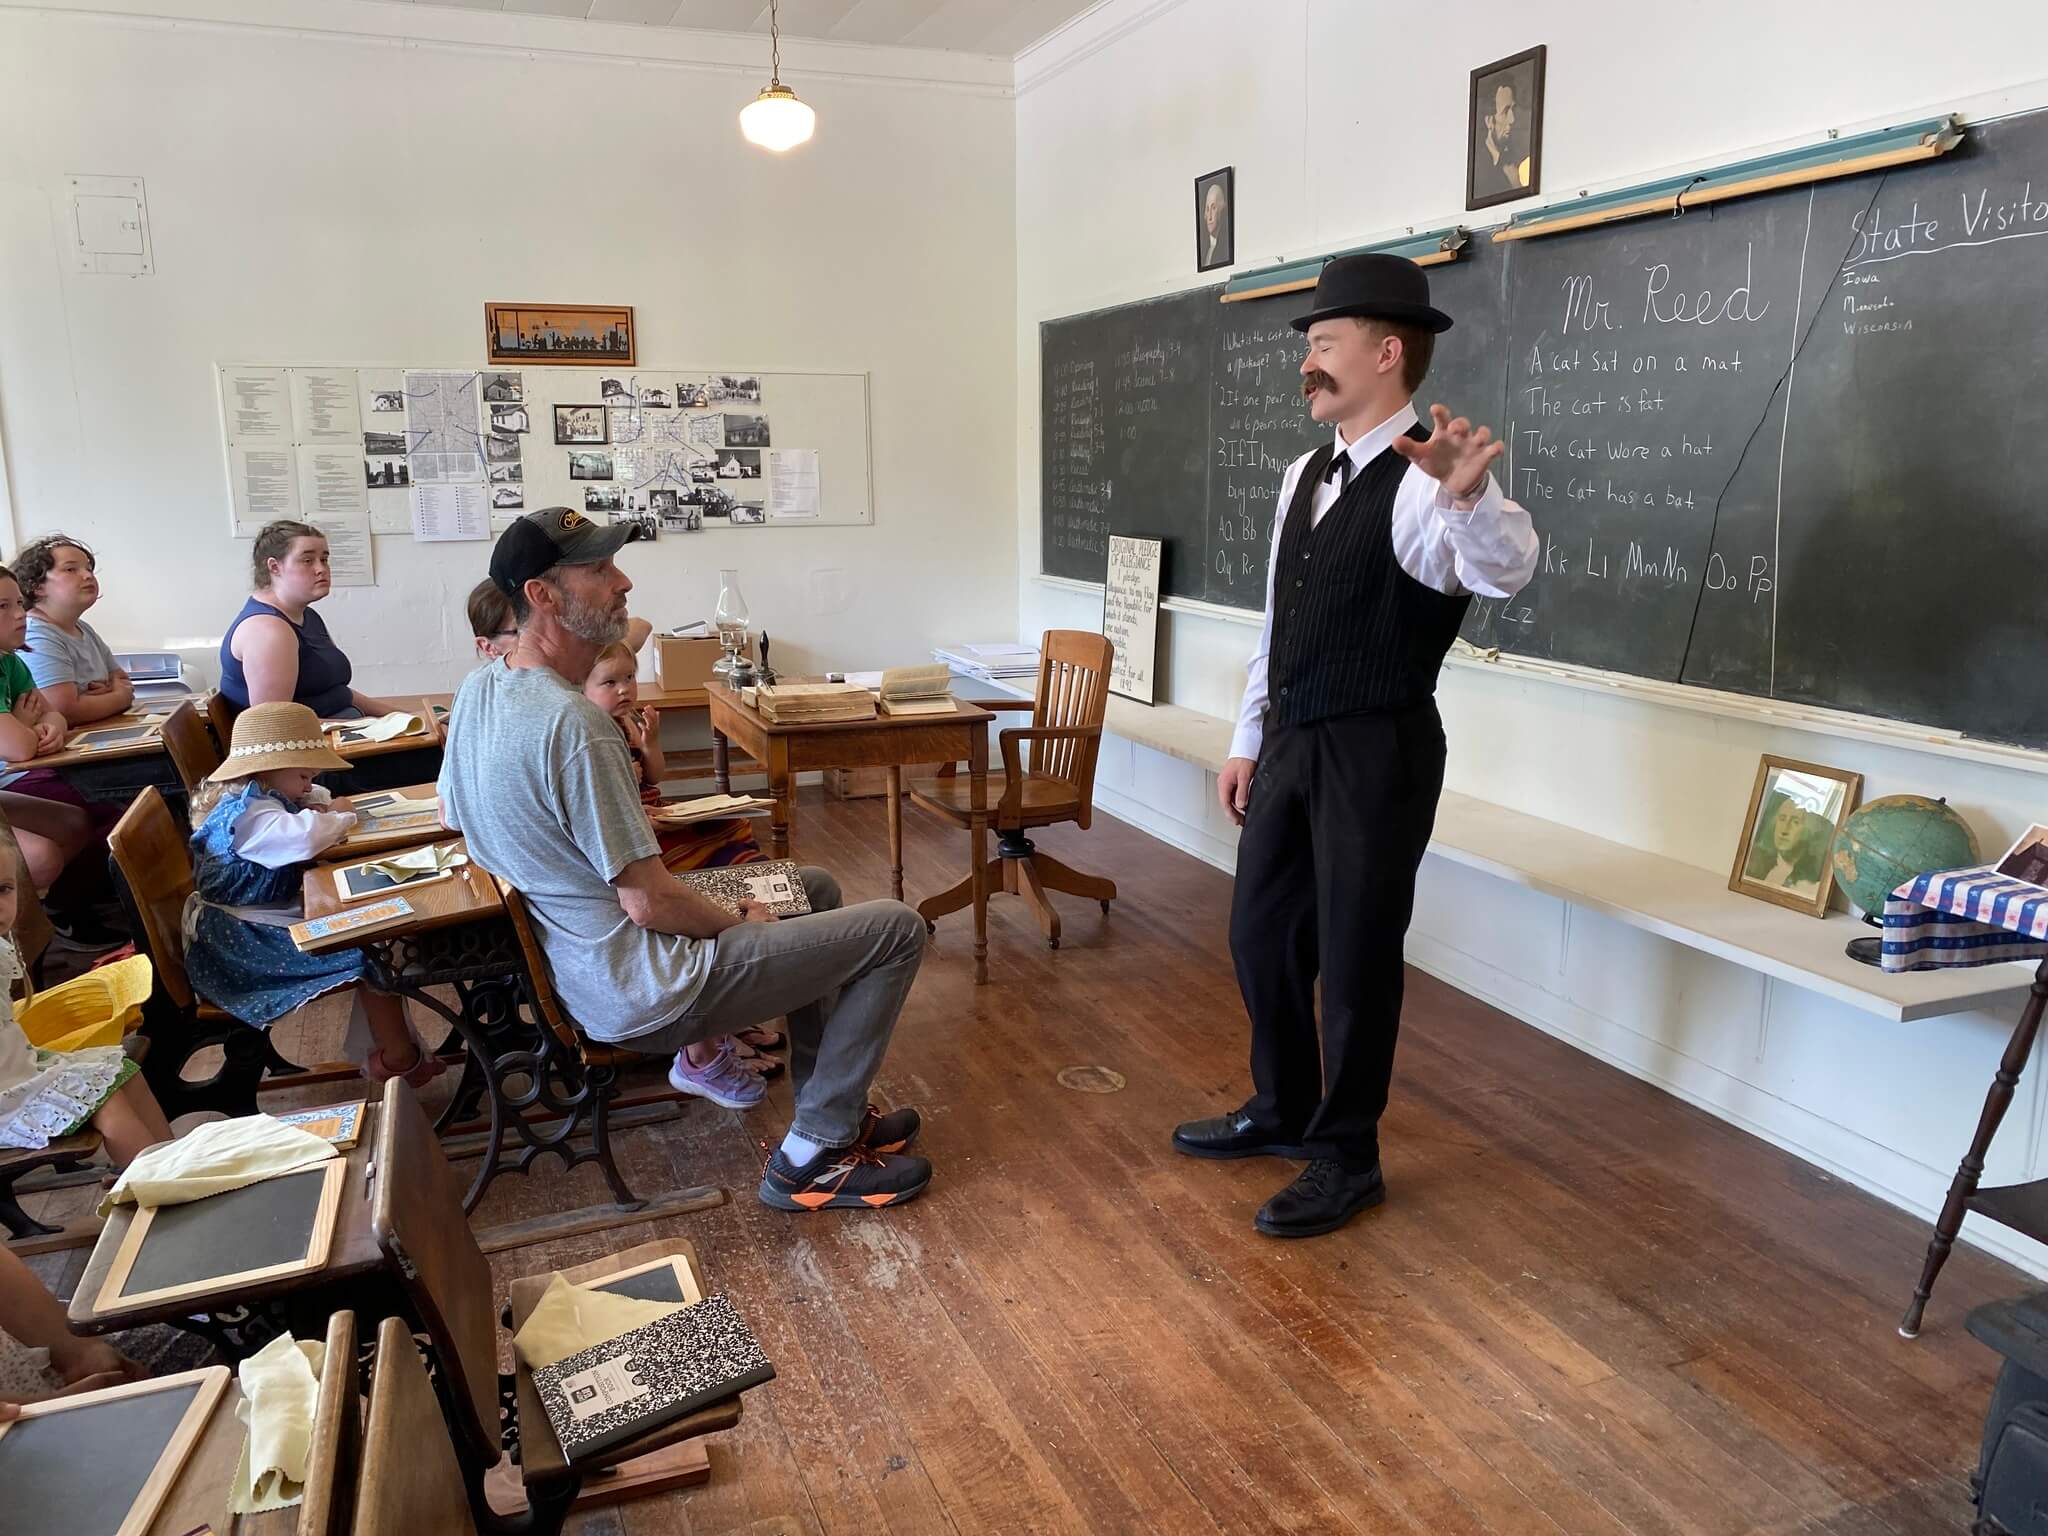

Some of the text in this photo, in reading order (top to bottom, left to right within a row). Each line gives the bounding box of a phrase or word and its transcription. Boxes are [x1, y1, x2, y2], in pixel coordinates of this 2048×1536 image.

[1845, 203, 1939, 262] State
[1561, 241, 1771, 334] Mr. Reed
[1842, 271, 1880, 286] Iowa
[1529, 345, 1544, 376] A
[1632, 355, 1657, 374] on
[1674, 355, 1688, 372] a
[1243, 396, 1261, 407] one
[1523, 386, 1562, 417] The
[1618, 395, 1632, 413] is
[1521, 430, 1558, 460] The
[1661, 446, 1673, 459] a
[1227, 473, 1246, 518] buy
[1519, 466, 1554, 499] The
[1607, 479, 1634, 505] has
[1643, 491, 1655, 506] a
[1242, 515, 1257, 541] Bb
[1111, 537, 1159, 559] ORIGINAL PLEDGE
[1111, 553, 1152, 571] OF ALLEGIANCE
[1122, 570, 1141, 587] pledge
[1242, 552, 1255, 576] Rr
[1543, 532, 1569, 575] Kk
[1626, 541, 1658, 581] Mm
[1662, 546, 1688, 583] Nn
[1705, 552, 1737, 591] Oo
[1748, 554, 1773, 604] Pp
